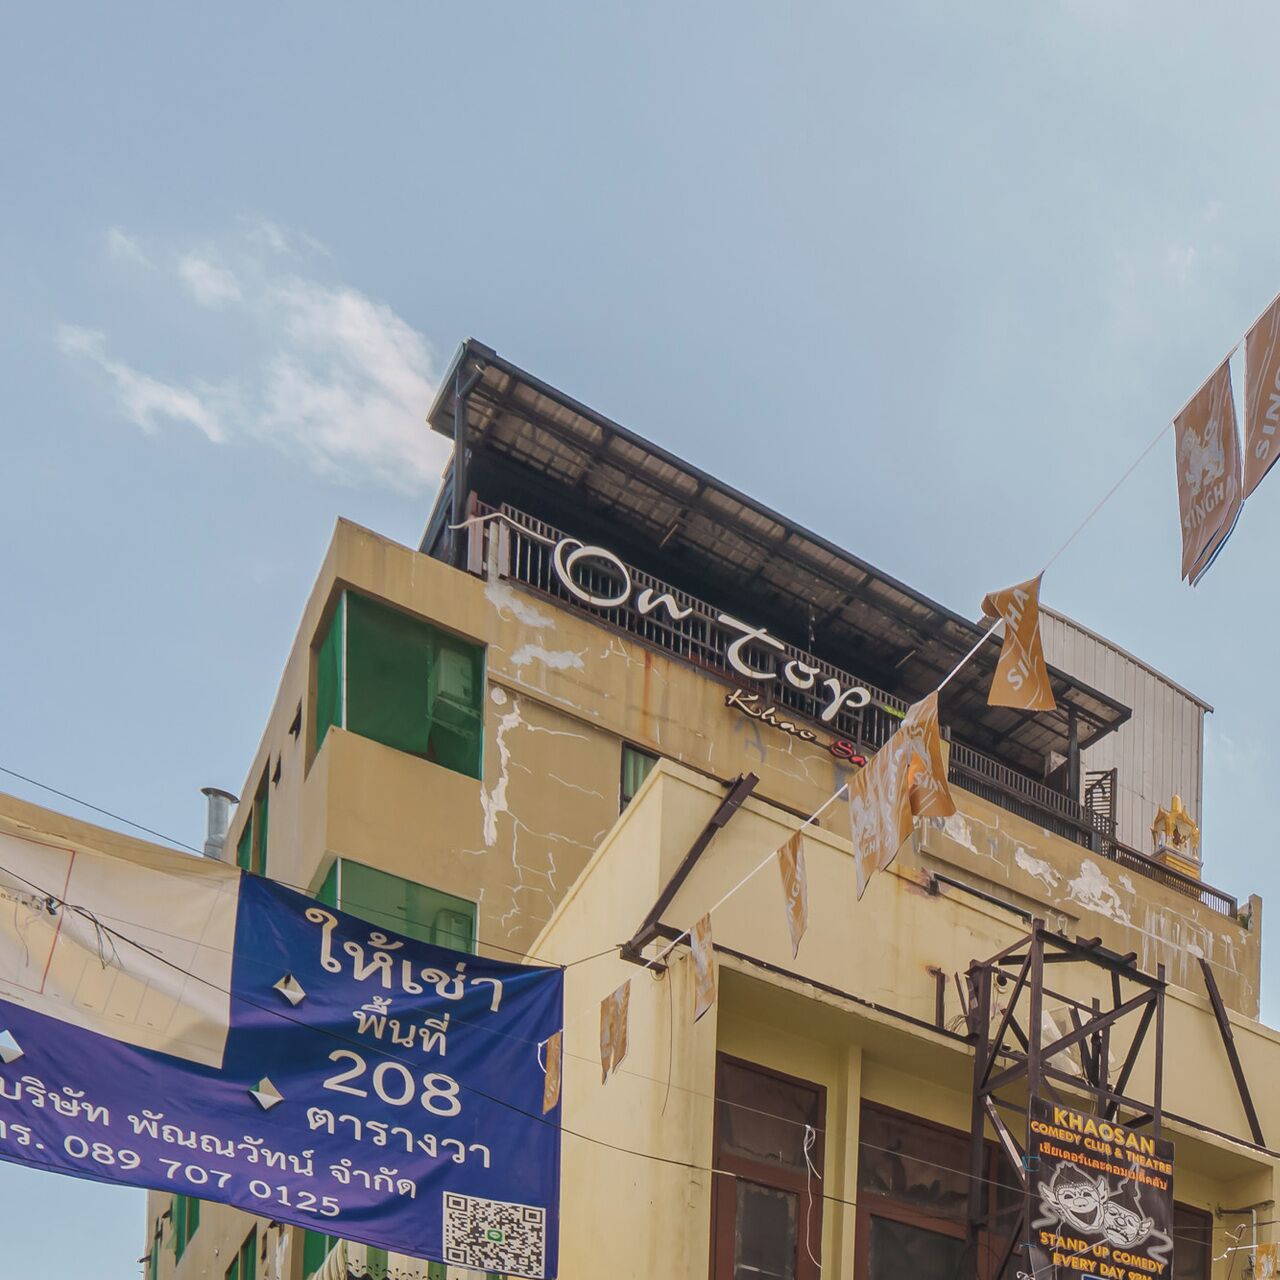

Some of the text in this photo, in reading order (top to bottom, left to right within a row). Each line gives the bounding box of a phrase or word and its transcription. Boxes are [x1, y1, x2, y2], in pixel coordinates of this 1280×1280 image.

[553, 538, 872, 721] On Top
[726, 688, 817, 742] Khao
[304, 907, 503, 1012] ให้เช่า
[352, 995, 450, 1056] พื้นที่
[322, 1049, 461, 1117] 208
[306, 1107, 491, 1168] ตารางวา
[1030, 1121, 1172, 1175] COMEDY CLUB & THEATRE
[1054, 1106, 1156, 1156] KHAOSAN
[64, 1135, 340, 1216] 089 707 0125
[329, 1159, 416, 1199] จำกัด
[1040, 1231, 1165, 1275] STAND UP COMEDY
[1052, 1252, 1097, 1272] EVERY
[1100, 1263, 1125, 1280] DAY
